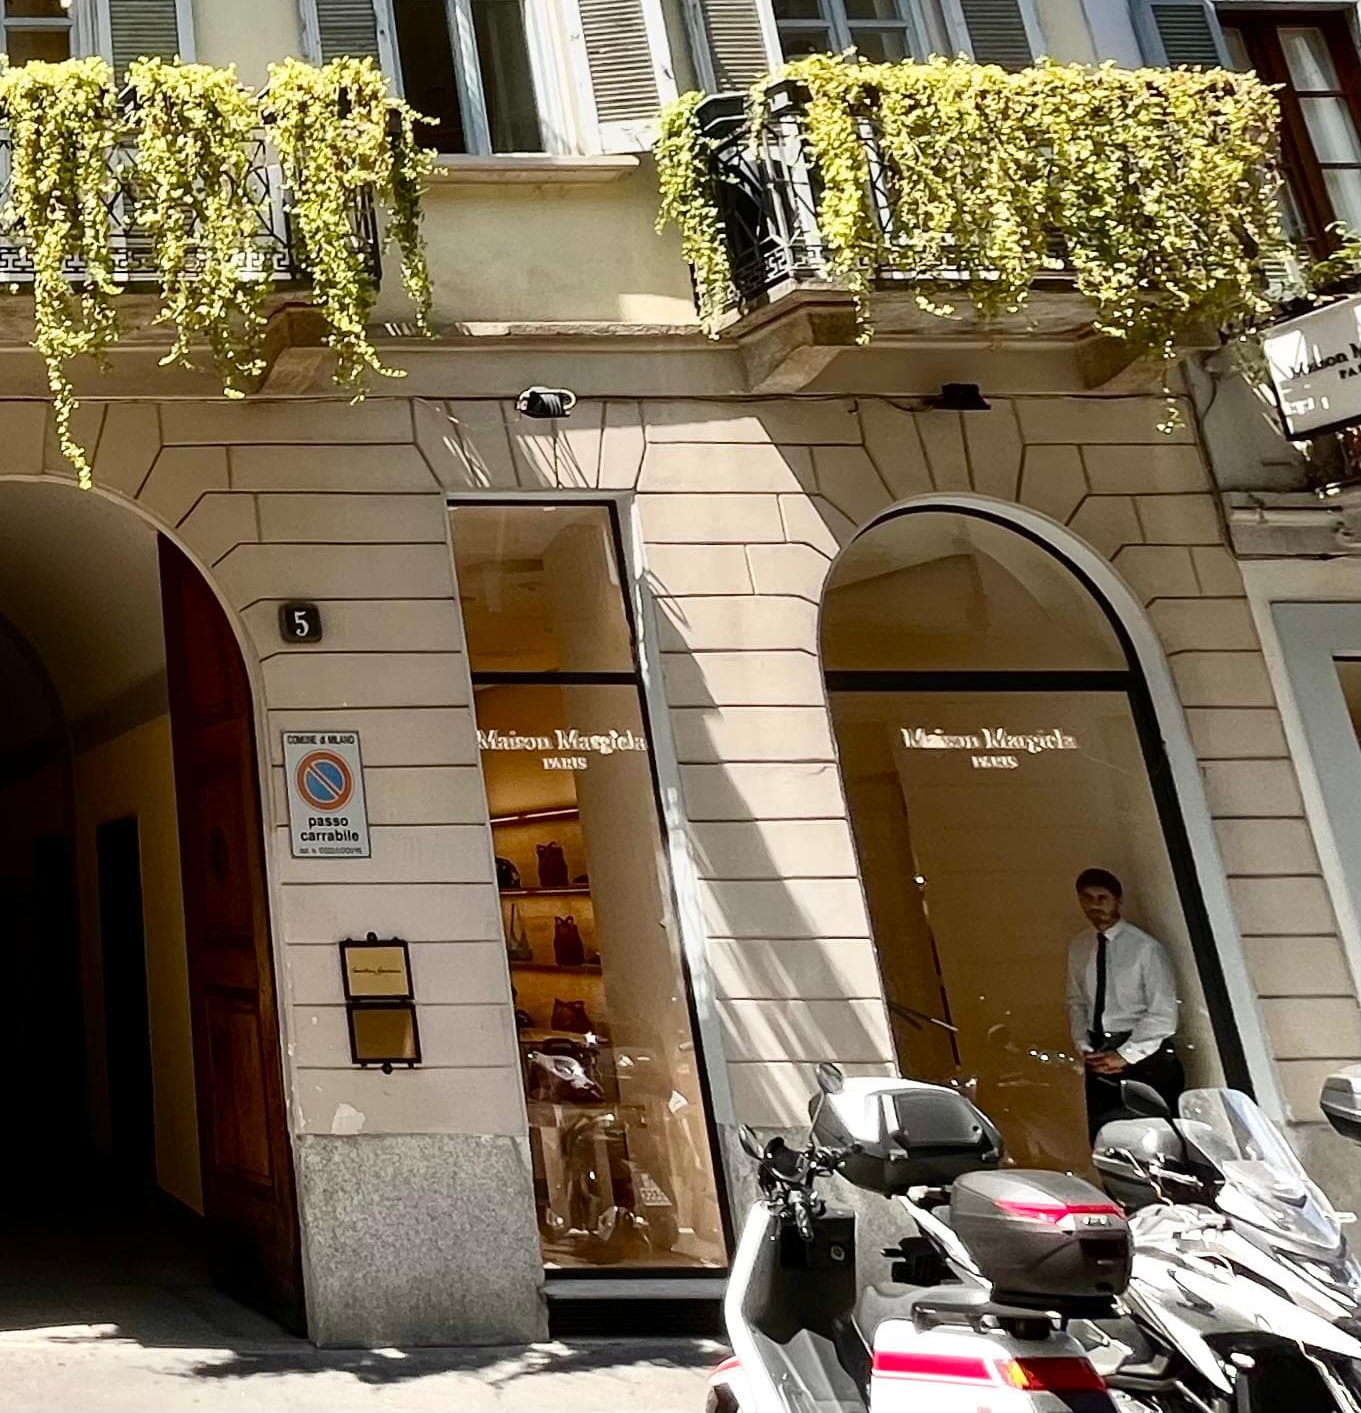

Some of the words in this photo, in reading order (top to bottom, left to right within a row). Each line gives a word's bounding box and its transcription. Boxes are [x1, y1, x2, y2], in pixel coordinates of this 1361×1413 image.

[294, 610, 310, 637] 5
[327, 735, 355, 745] MILANO
[476, 729, 554, 750] Maison
[554, 729, 648, 754] Margiela
[900, 728, 982, 749] Maison
[542, 757, 589, 770] PARIS
[308, 817, 349, 828] passo
[300, 830, 360, 842] carrabile
